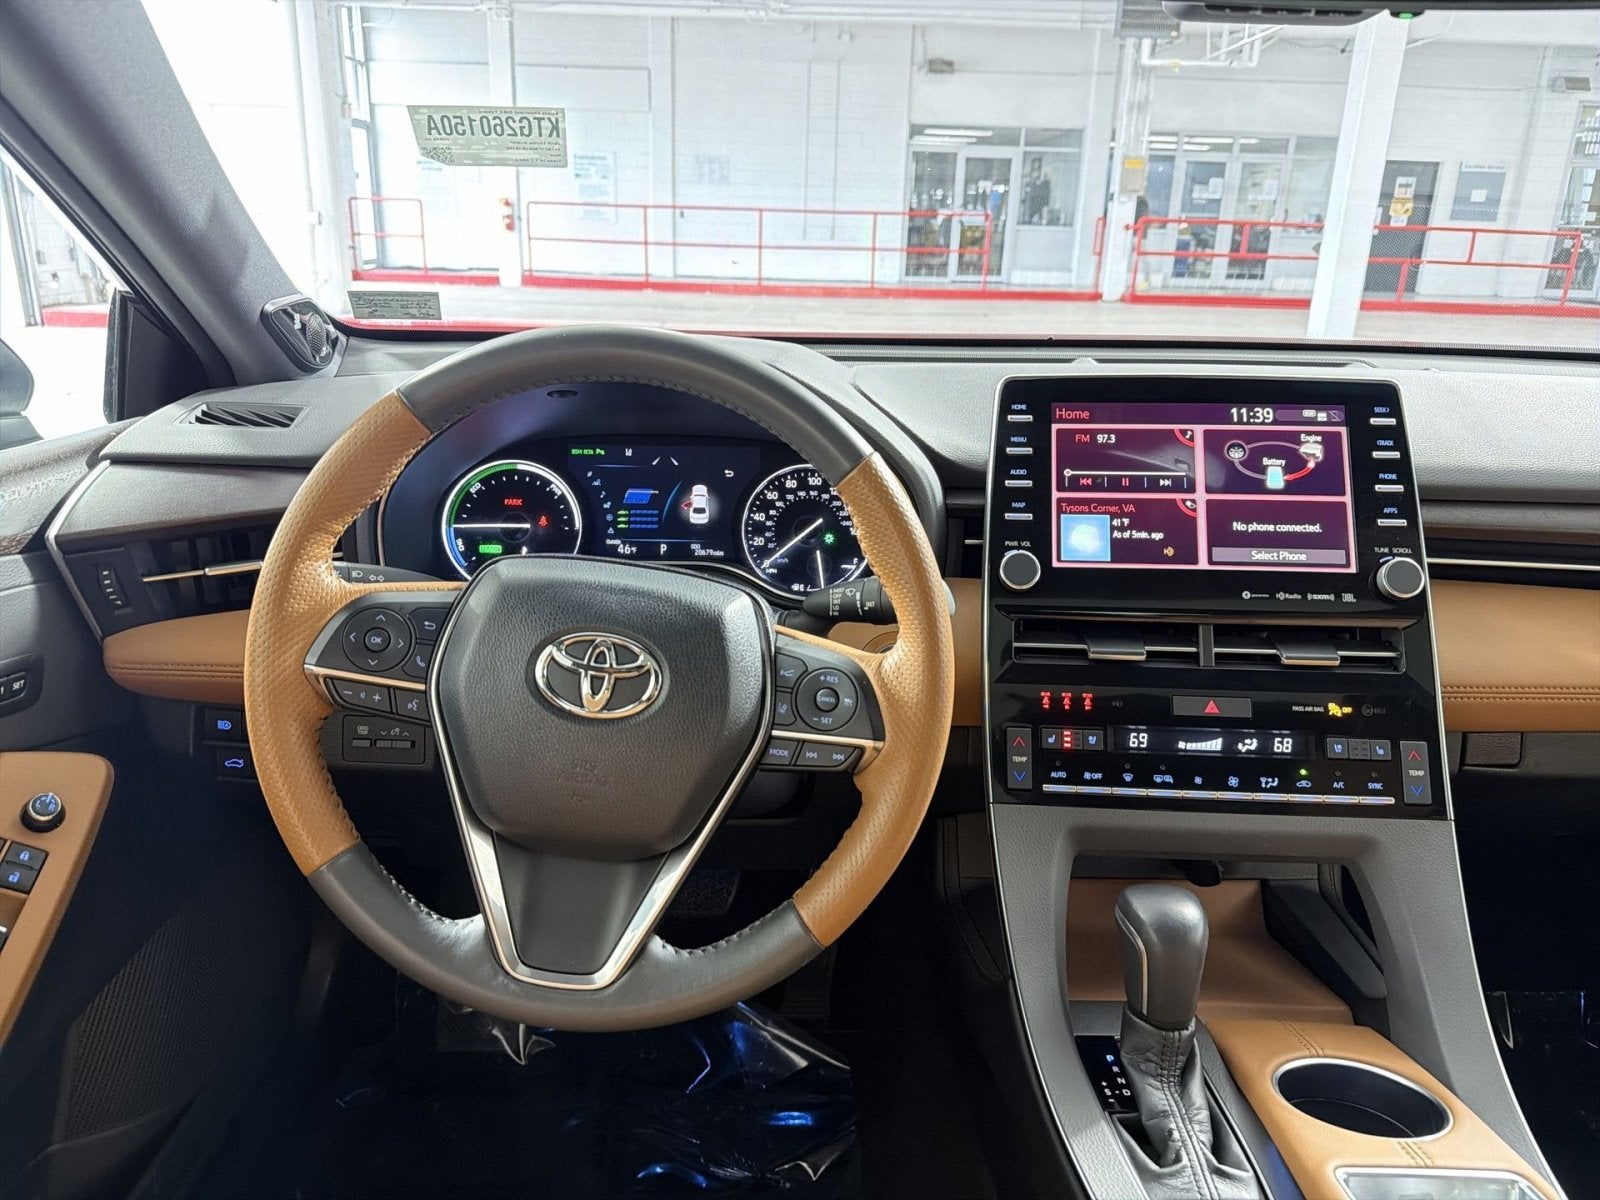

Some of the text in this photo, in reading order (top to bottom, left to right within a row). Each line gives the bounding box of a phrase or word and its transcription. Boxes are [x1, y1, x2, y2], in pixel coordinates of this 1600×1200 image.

[1056, 408, 1090, 419] Home
[1230, 407, 1274, 422] 11:39
[1075, 434, 1116, 443] FM 97.3
[1300, 434, 1322, 442] Engine
[1262, 458, 1286, 467] Battery
[785, 480, 797, 488] 80
[808, 478, 822, 486] 100
[766, 492, 778, 500] 60
[1060, 503, 1136, 513] Tysons Corner, VA
[754, 513, 766, 521] 40
[1232, 522, 1323, 533] No phone connected.
[1112, 530, 1164, 540] As of 5min. ago
[753, 538, 765, 546] 20
[660, 544, 667, 555] P
[1251, 551, 1307, 561] Select Phone
[1342, 593, 1356, 602] JBL
[370, 636, 382, 644] OK
[826, 676, 838, 684] RES
[12, 680, 26, 690] SET
[1130, 732, 1148, 748] 69
[1274, 738, 1292, 752] 68
[769, 748, 789, 756] MODE
[48, 802, 56, 811] R
[1106, 1054, 1114, 1062] P
